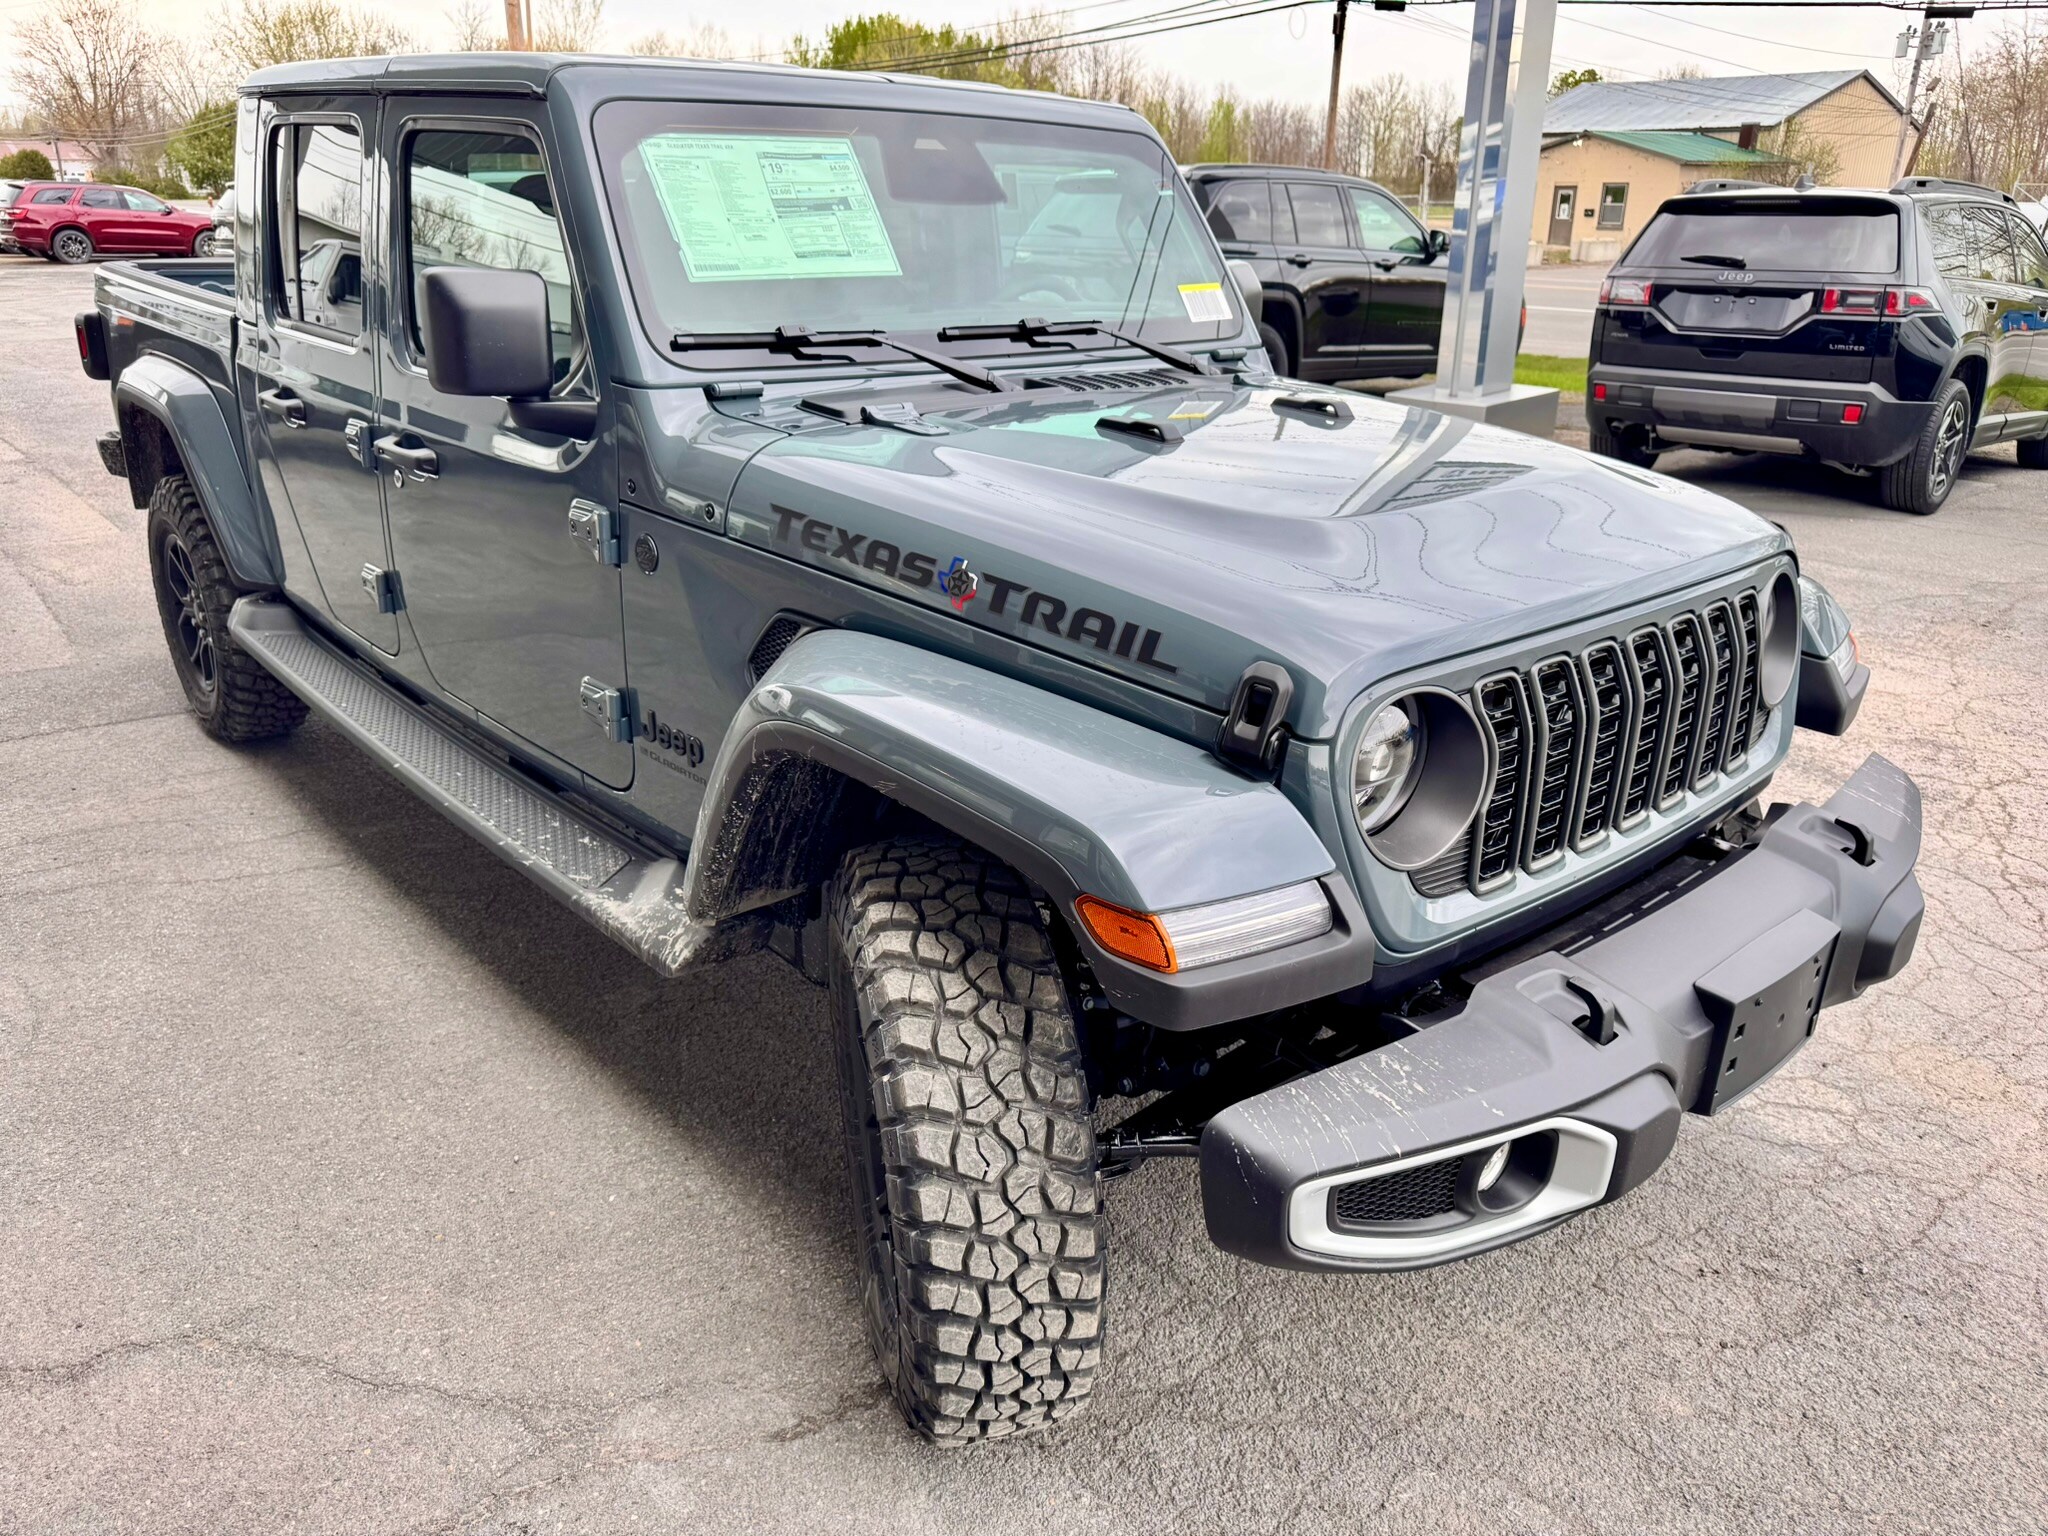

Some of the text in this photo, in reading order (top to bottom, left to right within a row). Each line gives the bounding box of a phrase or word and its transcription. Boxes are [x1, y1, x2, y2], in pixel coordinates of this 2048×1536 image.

[768, 163, 783, 174] 19
[1718, 271, 1754, 283] Jeep
[770, 503, 1178, 674] TEXAS TRAIL
[642, 709, 704, 768] Jeep
[649, 751, 707, 788] GLADIATOR
